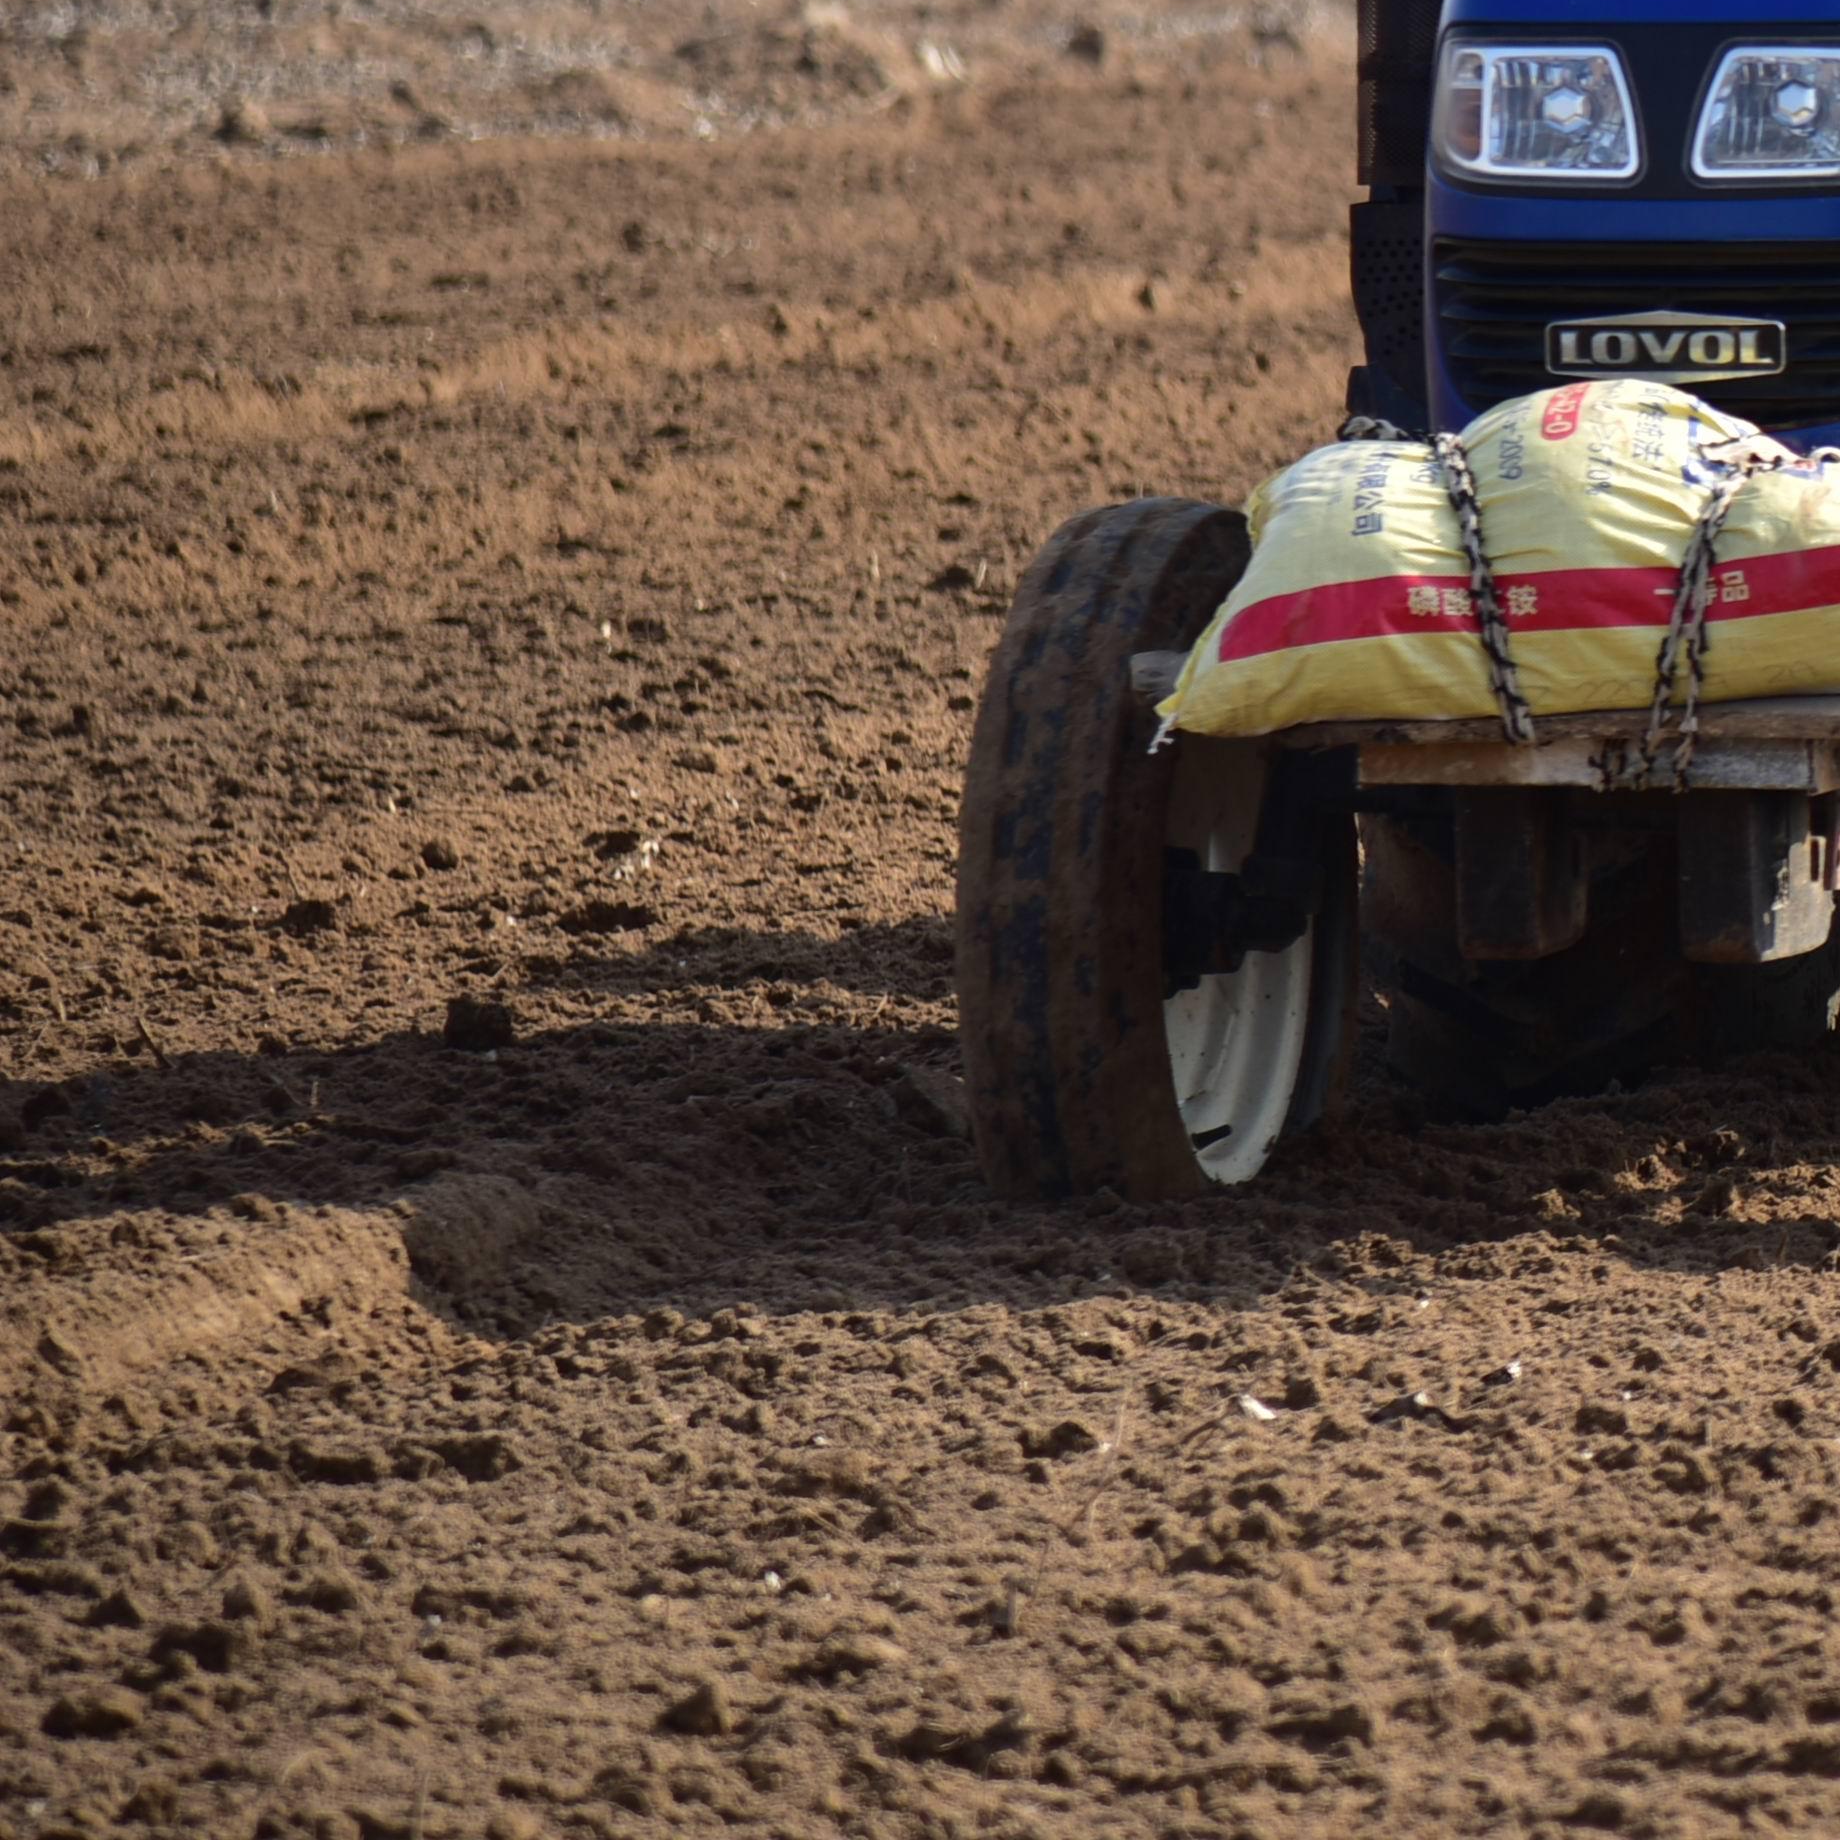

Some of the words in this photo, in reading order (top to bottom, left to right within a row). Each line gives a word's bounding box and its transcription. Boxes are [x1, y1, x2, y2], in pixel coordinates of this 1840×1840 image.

[1558, 330, 1776, 365] LOVOL
[1406, 584, 1539, 617] 磷酸铵
